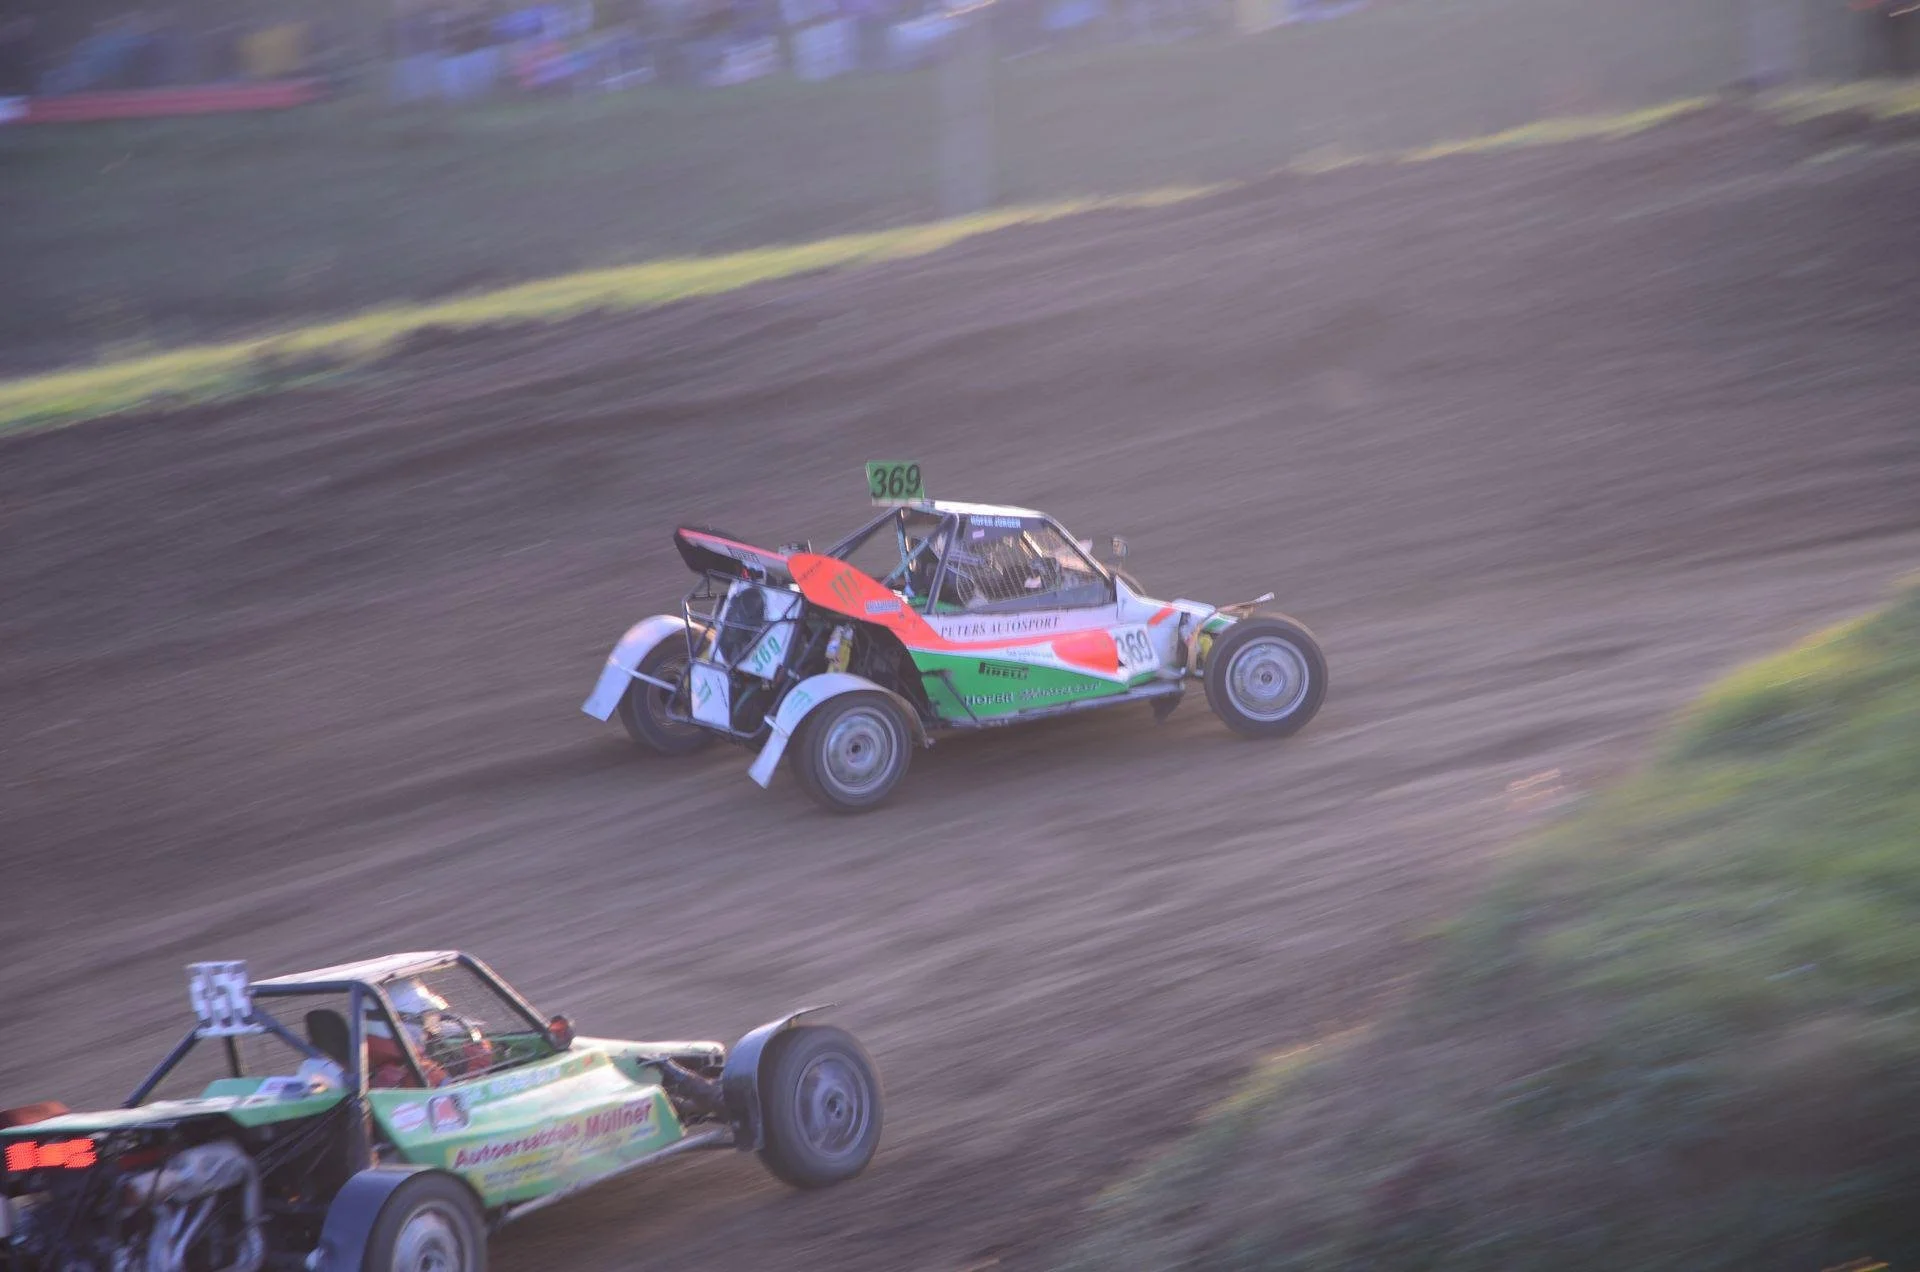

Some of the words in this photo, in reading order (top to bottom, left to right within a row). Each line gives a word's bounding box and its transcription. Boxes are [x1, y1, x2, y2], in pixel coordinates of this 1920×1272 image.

[871, 464, 921, 498] 369
[941, 622, 986, 637] PETERS
[991, 615, 1060, 634] AUTOSPORT
[1115, 629, 1153, 668] 369
[978, 662, 1029, 679] PIRELLI
